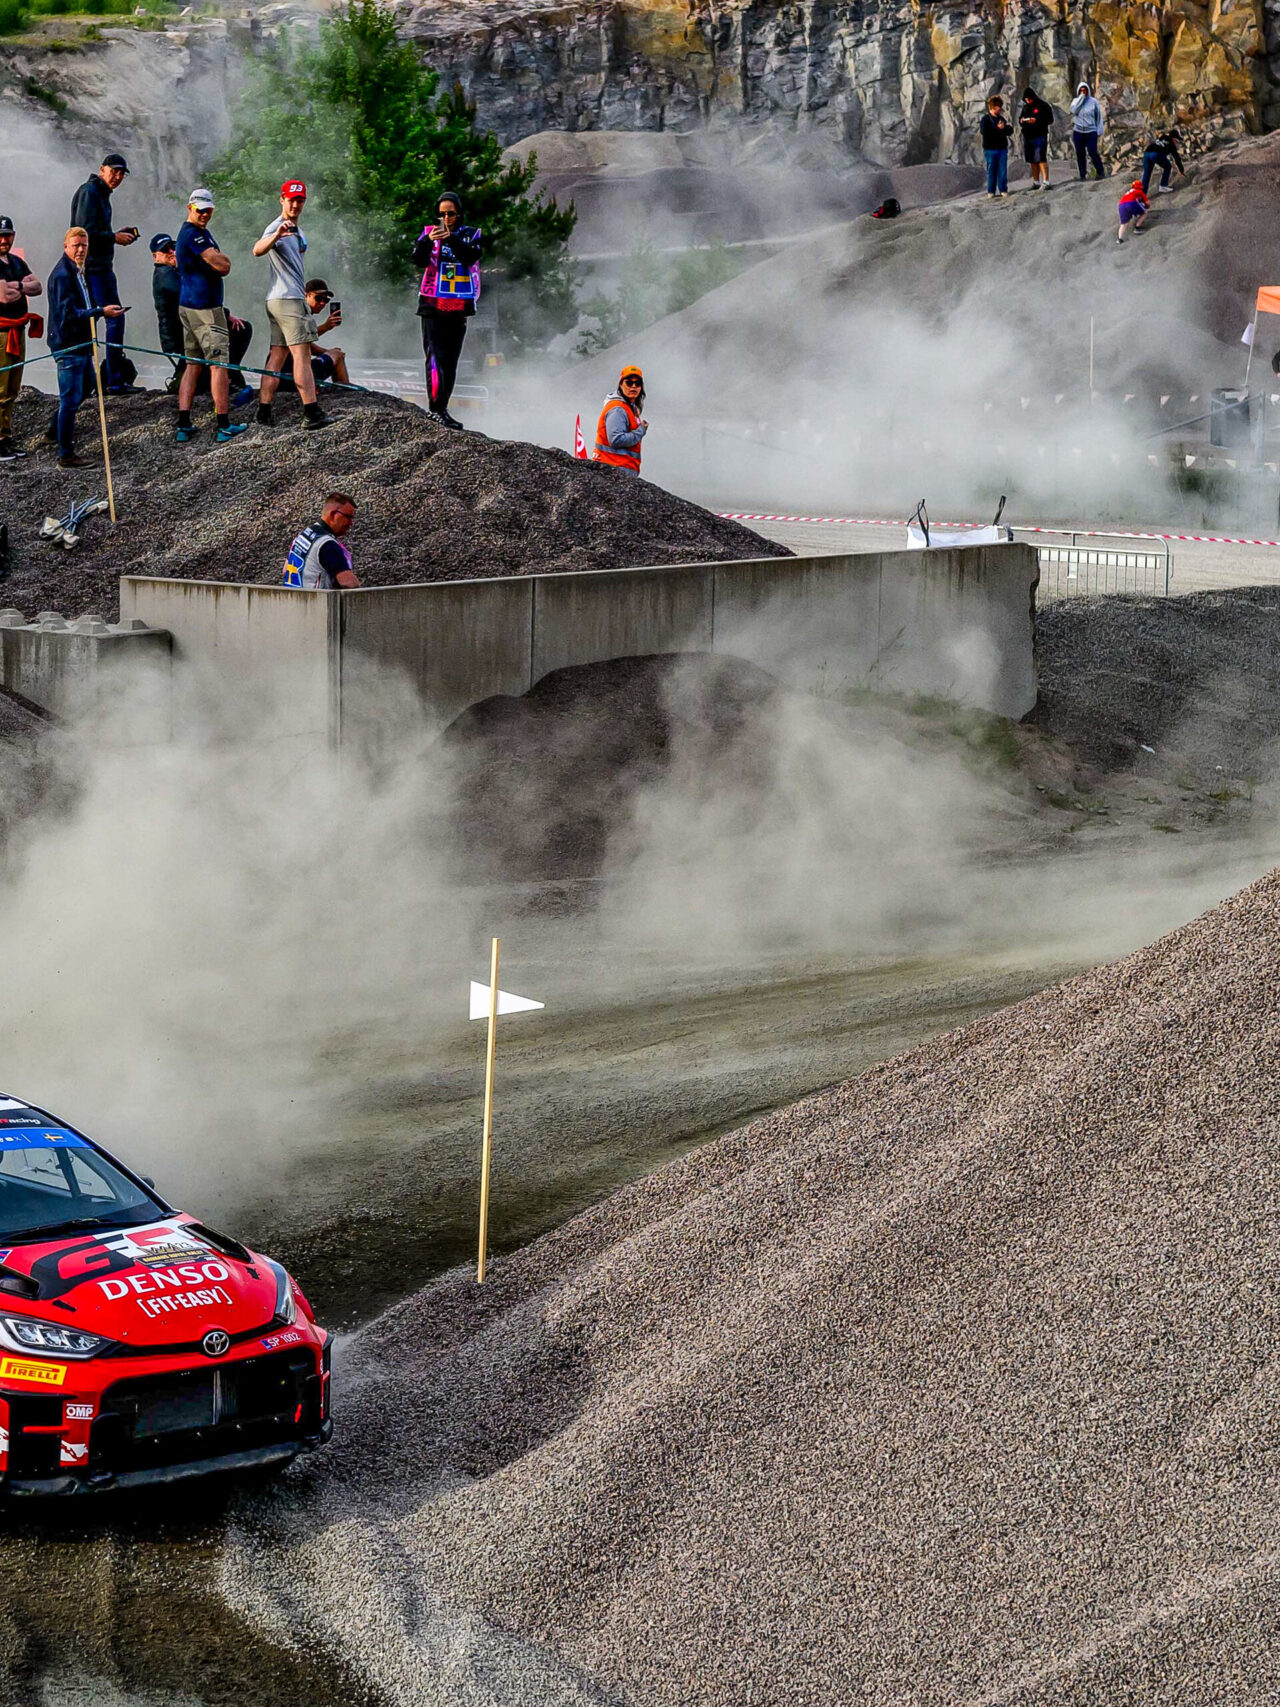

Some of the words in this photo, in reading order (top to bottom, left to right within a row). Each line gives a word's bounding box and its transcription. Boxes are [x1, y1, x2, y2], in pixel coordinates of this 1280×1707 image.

[97, 1262, 229, 1301] DENSO
[5, 1362, 60, 1380] PIRELLI
[66, 1405, 93, 1418] OMP
